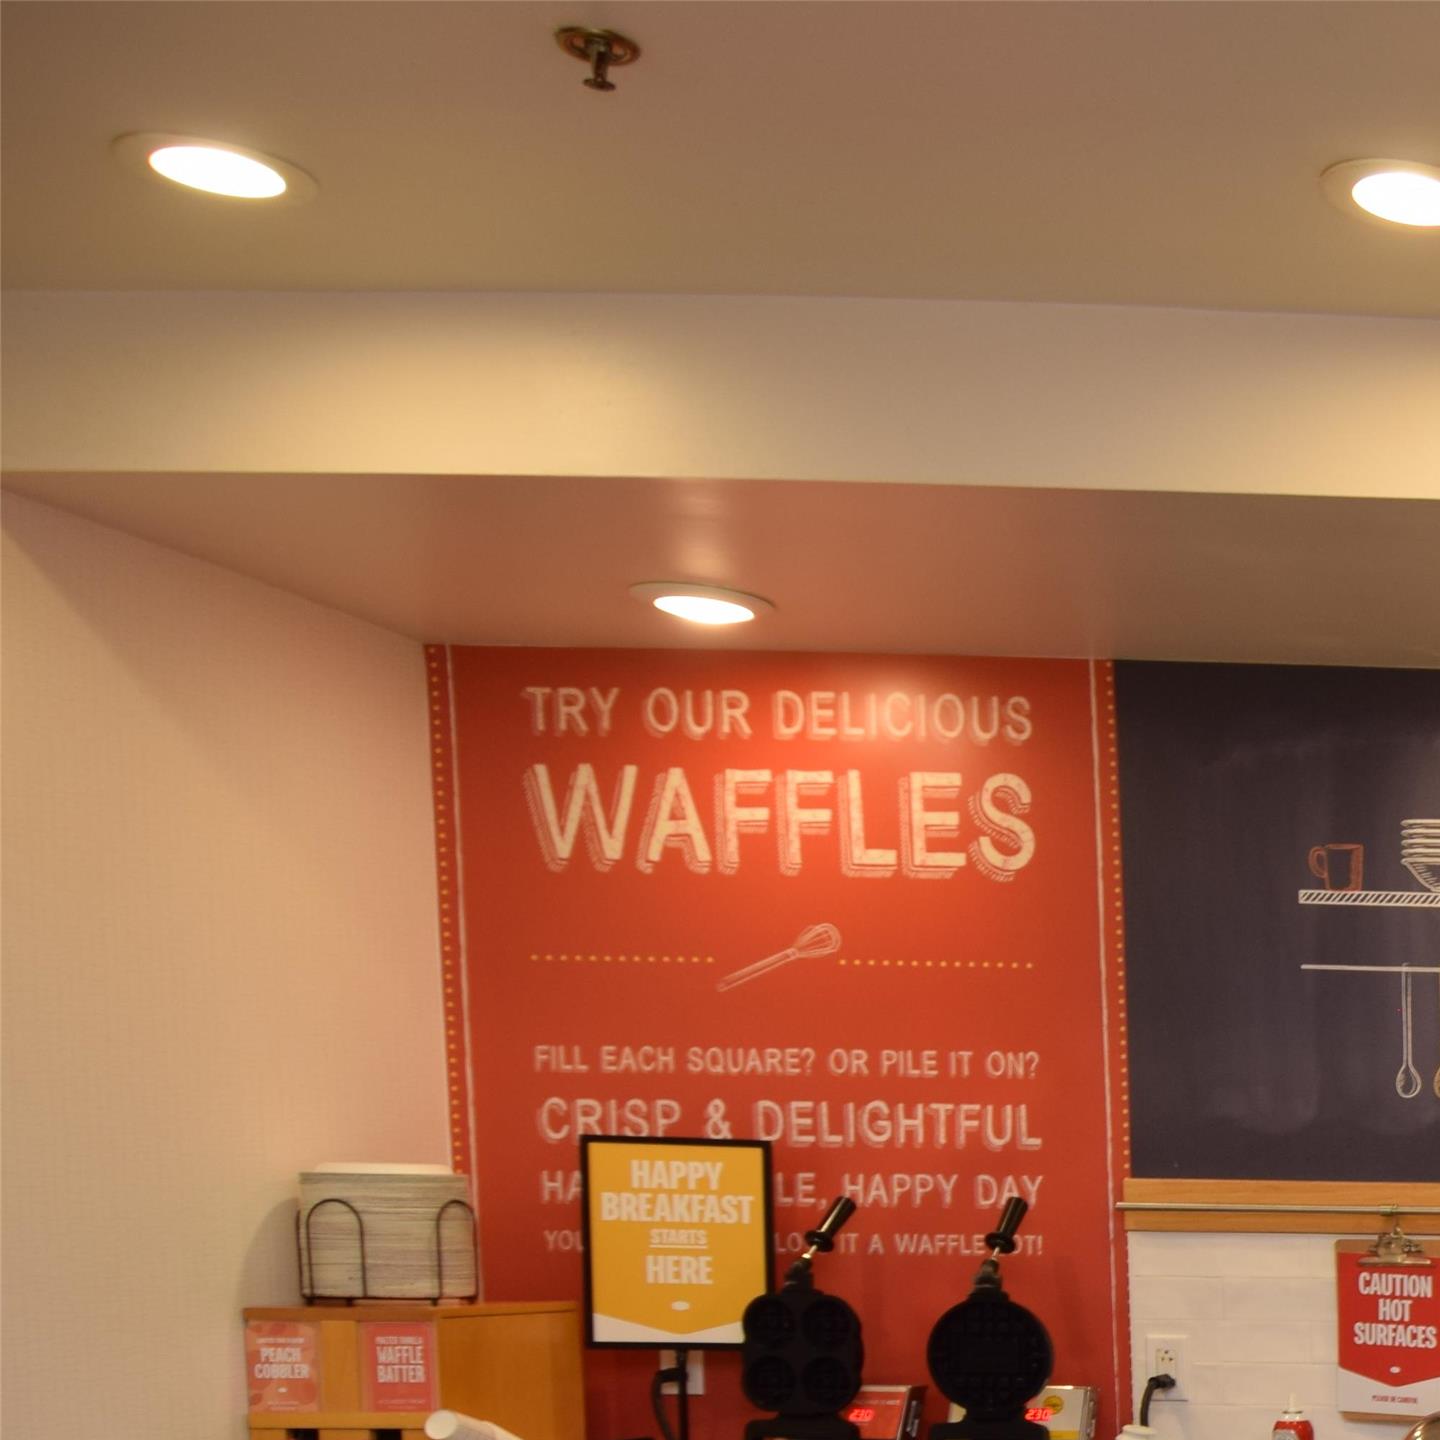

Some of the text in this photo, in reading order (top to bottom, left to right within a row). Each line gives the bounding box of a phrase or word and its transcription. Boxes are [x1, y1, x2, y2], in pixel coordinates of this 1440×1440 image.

[522, 686, 1033, 745] TRY OUR DELICIOUS
[523, 763, 1035, 882] WAFFLES
[534, 1045, 1040, 1079] FILL EACH SQUARE? OR PILE IT ON?
[538, 1097, 1042, 1150] CRISP & DELIGHTFUL
[630, 1159, 723, 1190] HAPPY
[842, 1172, 958, 1208] HAPPY
[975, 1173, 1044, 1209] DAY
[600, 1191, 755, 1225] BREAKFAST
[650, 1228, 708, 1245] STARTS
[869, 1234, 884, 1254] A
[895, 1234, 985, 1256] WAFFLE
[645, 1255, 713, 1285] HERE
[1358, 1272, 1434, 1298] CAUTION
[1378, 1298, 1413, 1322] HOT
[1353, 1322, 1438, 1349] SURFACES
[259, 1347, 302, 1363] PEACH
[376, 1346, 424, 1364] WAFFLE
[254, 1363, 310, 1379] COBBLER
[377, 1365, 426, 1383] BATTER
[1025, 1408, 1050, 1421] 230
